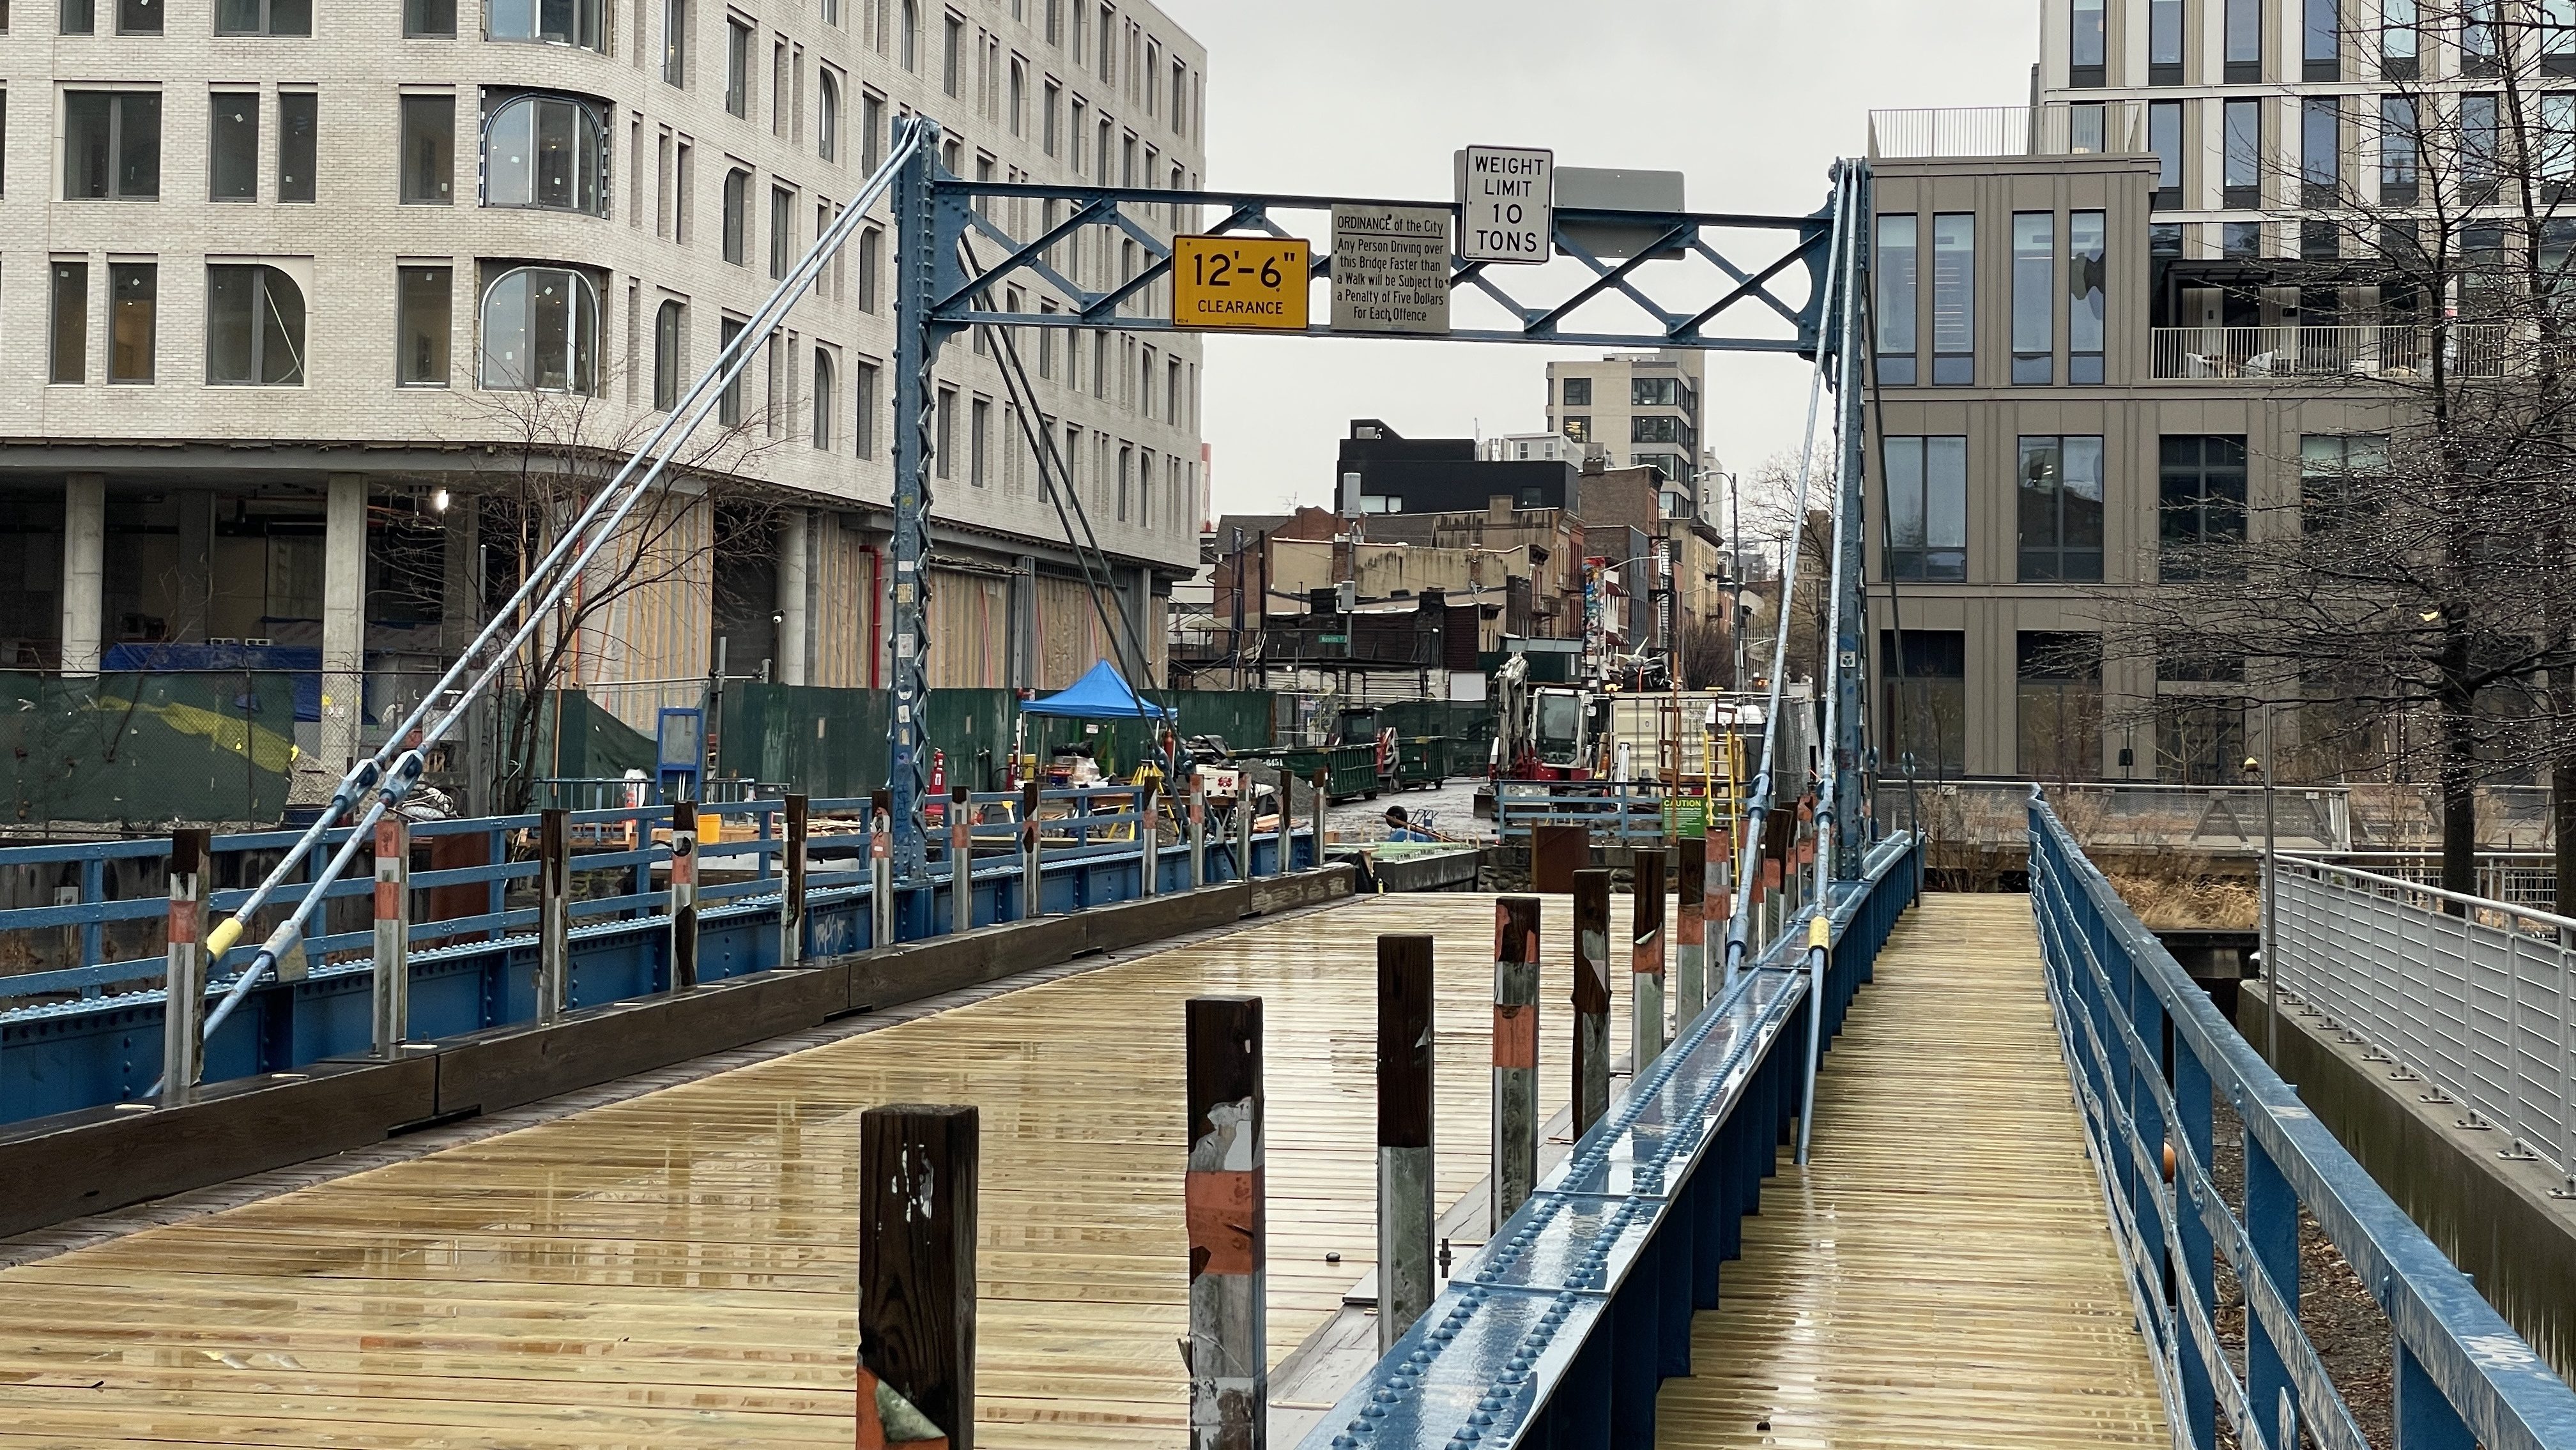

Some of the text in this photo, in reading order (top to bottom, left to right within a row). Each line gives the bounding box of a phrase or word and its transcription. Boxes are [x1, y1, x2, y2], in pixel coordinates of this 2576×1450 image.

[1475, 156, 1544, 175] WEIGHT
[1485, 178, 1532, 197] LIMIT
[1493, 203, 1522, 224] 10
[1337, 215, 1443, 236] ORDINANCE of the City
[1337, 238, 1444, 257] Any Person Driving over
[1476, 229, 1537, 252] TONS
[1193, 250, 1295, 288] 12'-6"
[1340, 256, 1441, 272] this Bridge Faster than
[1337, 272, 1444, 291] a Walk will be Subject to
[1337, 289, 1444, 305] a Penalty of Five Dollars
[1197, 299, 1284, 315] CLEARANCE
[1354, 306, 1427, 321] For Each Offence
